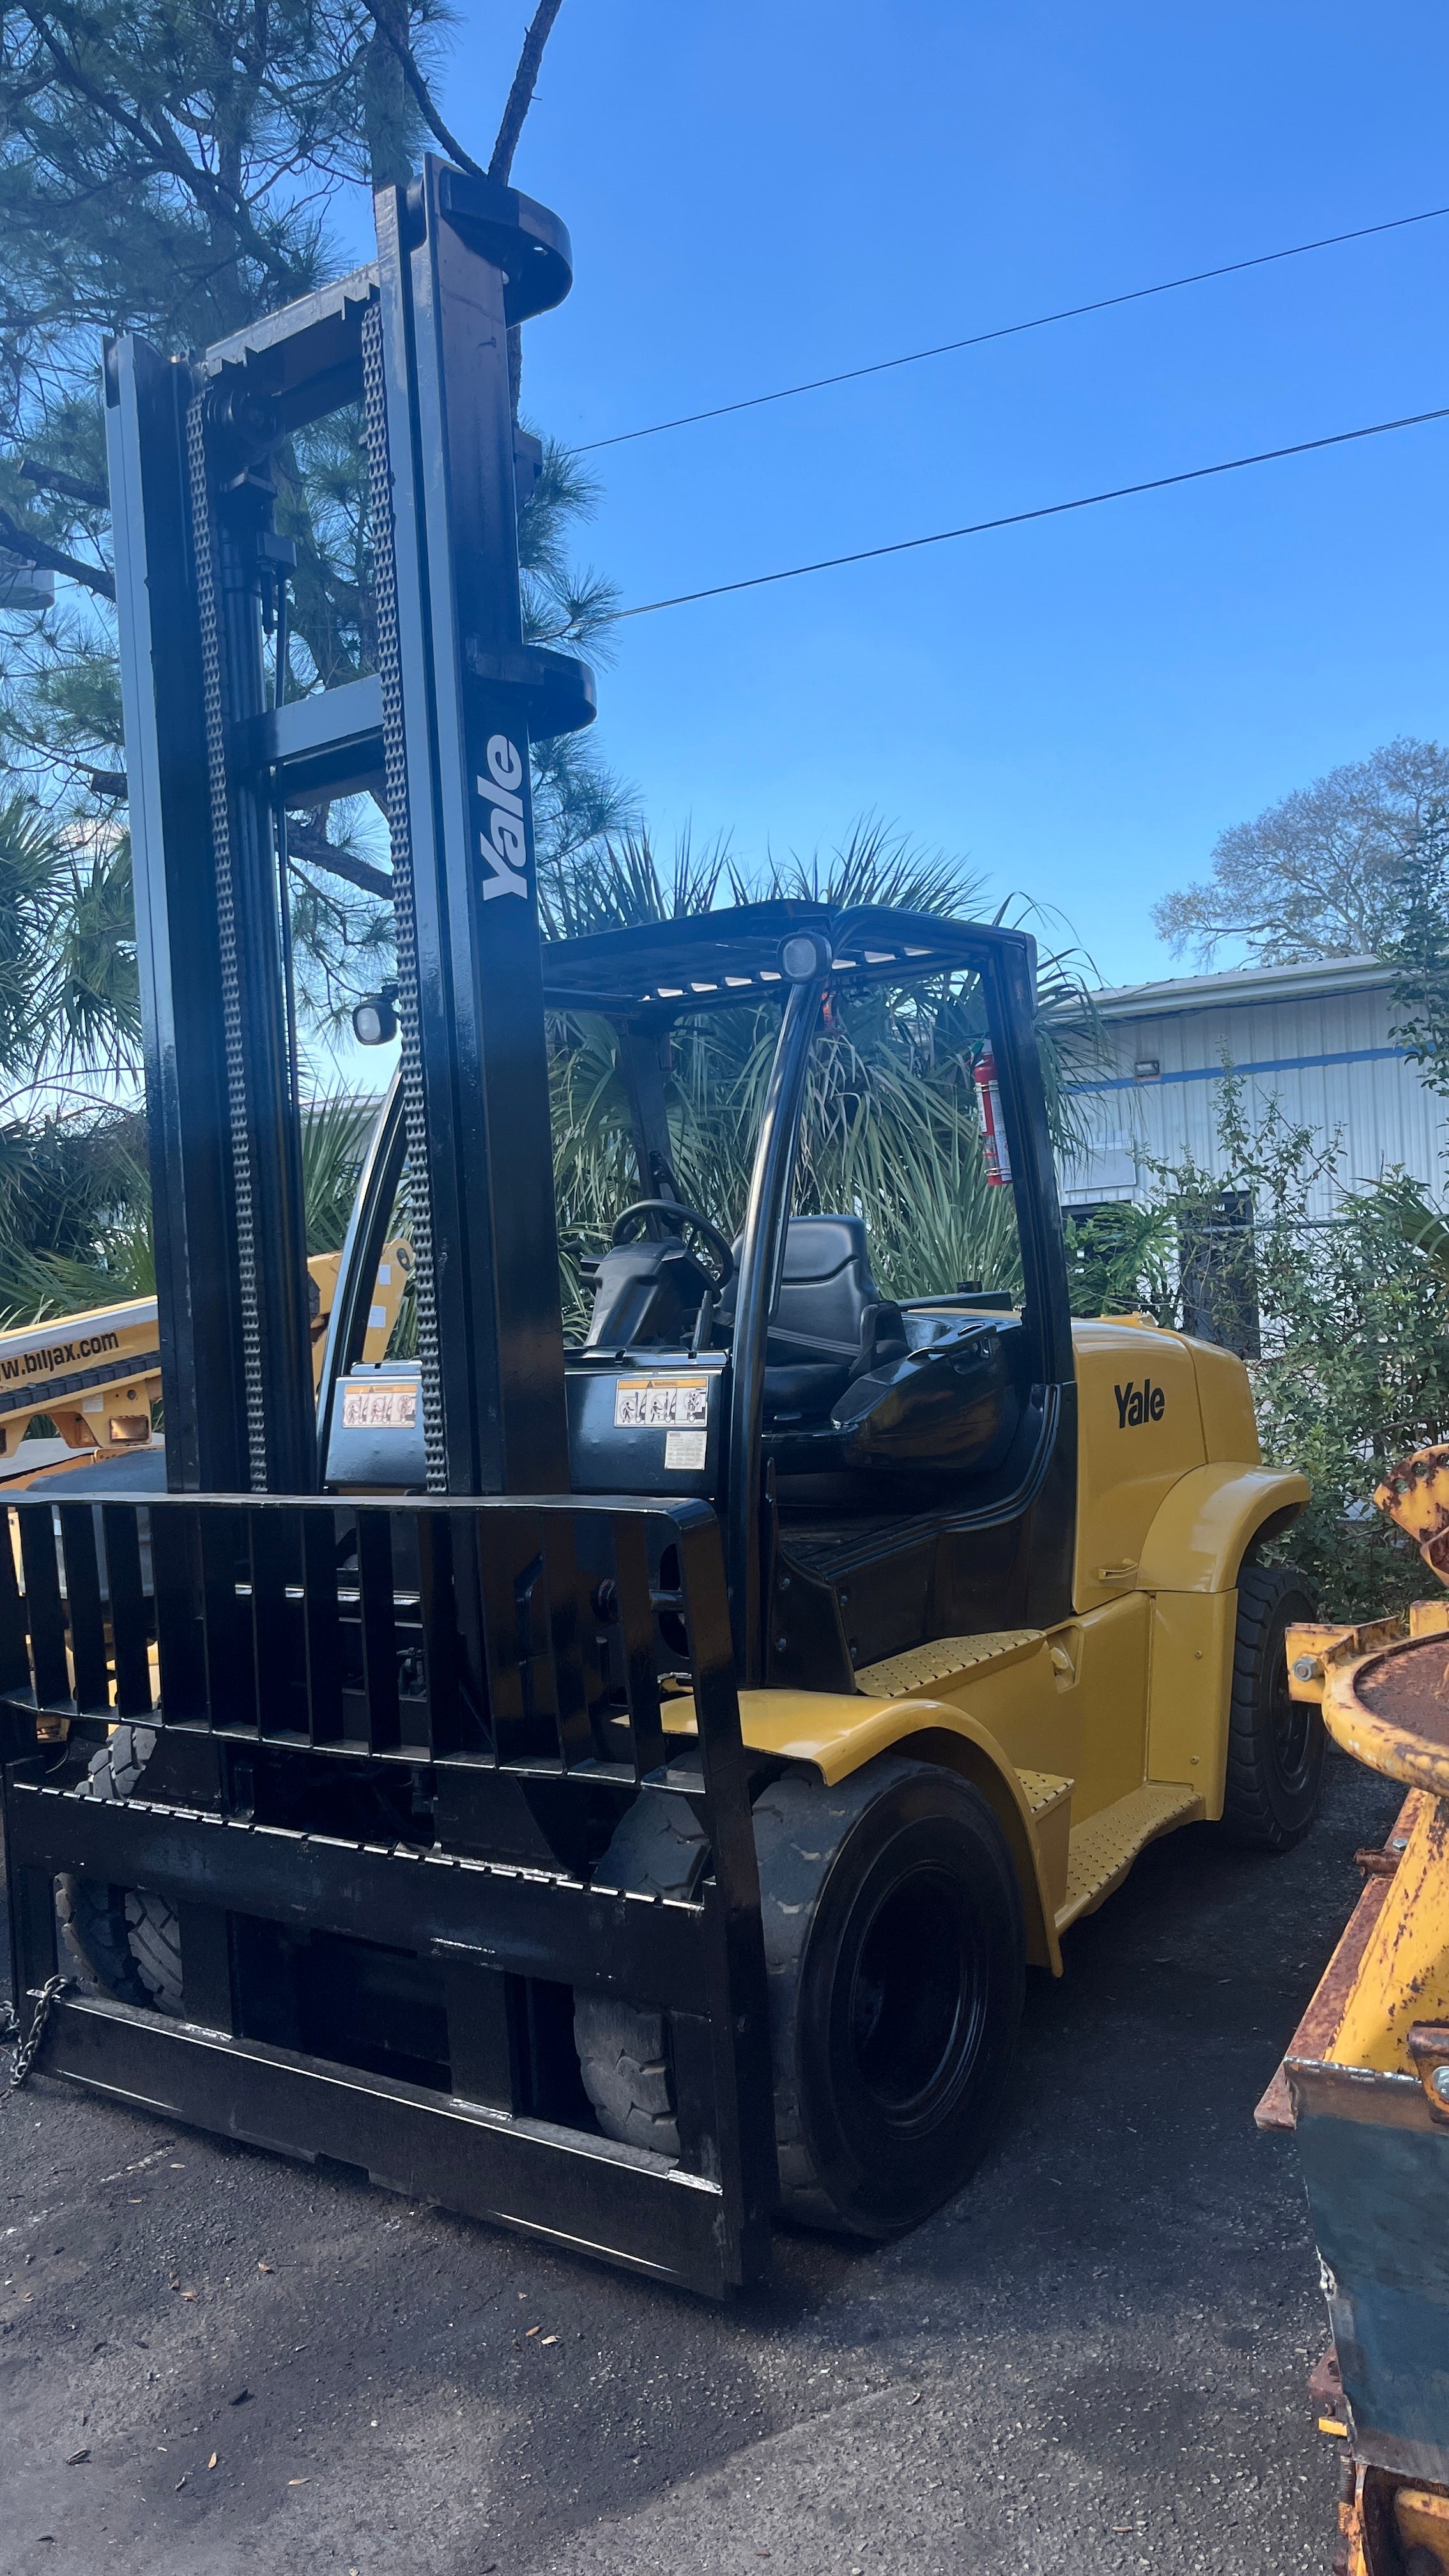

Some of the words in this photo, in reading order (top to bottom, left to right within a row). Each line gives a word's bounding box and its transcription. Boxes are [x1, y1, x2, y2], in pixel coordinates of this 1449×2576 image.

[477, 734, 528, 901] Yale
[0, 1332, 119, 1381] w.biljax.com
[1114, 1378, 1165, 1429] Yale
